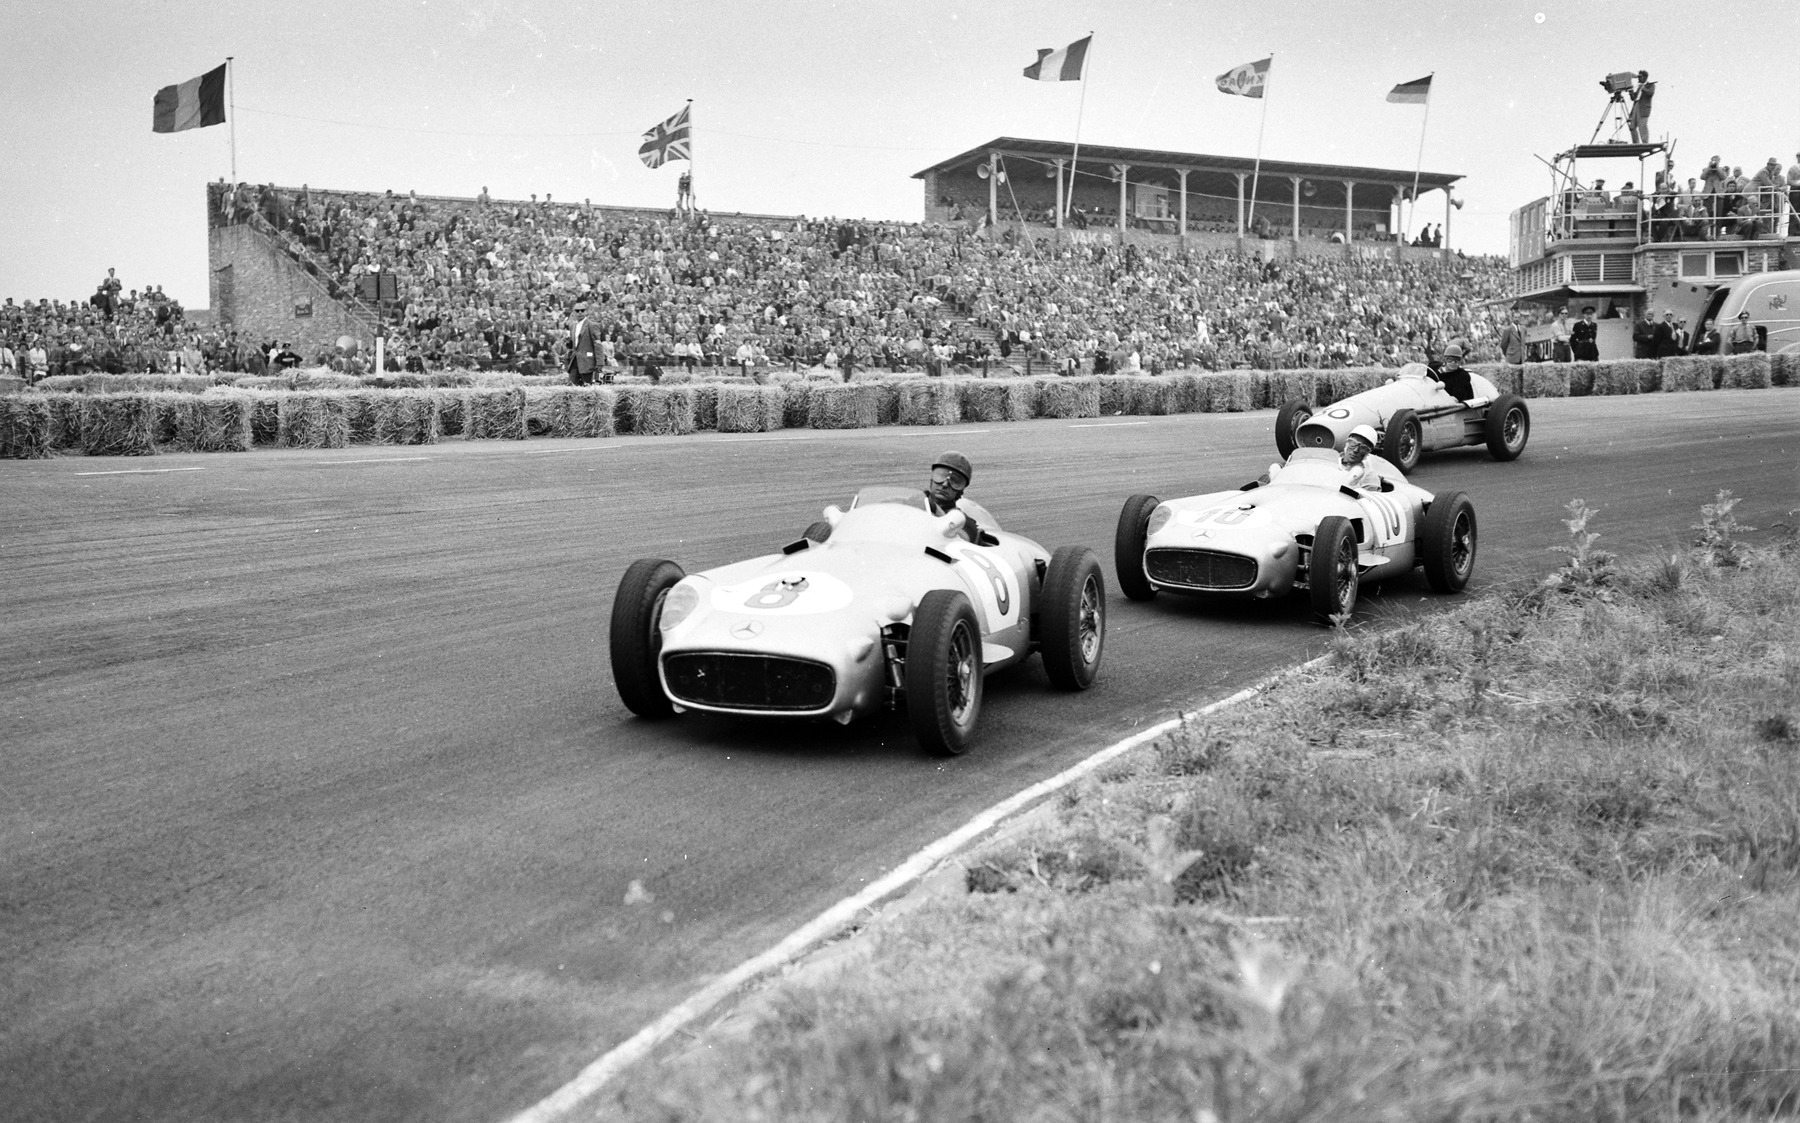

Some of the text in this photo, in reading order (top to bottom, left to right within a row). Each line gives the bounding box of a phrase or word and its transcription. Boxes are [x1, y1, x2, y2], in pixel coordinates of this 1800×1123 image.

[1194, 507, 1254, 525] 10
[1366, 493, 1401, 541] 10
[743, 576, 810, 610] 8
[959, 548, 1010, 616] 8
